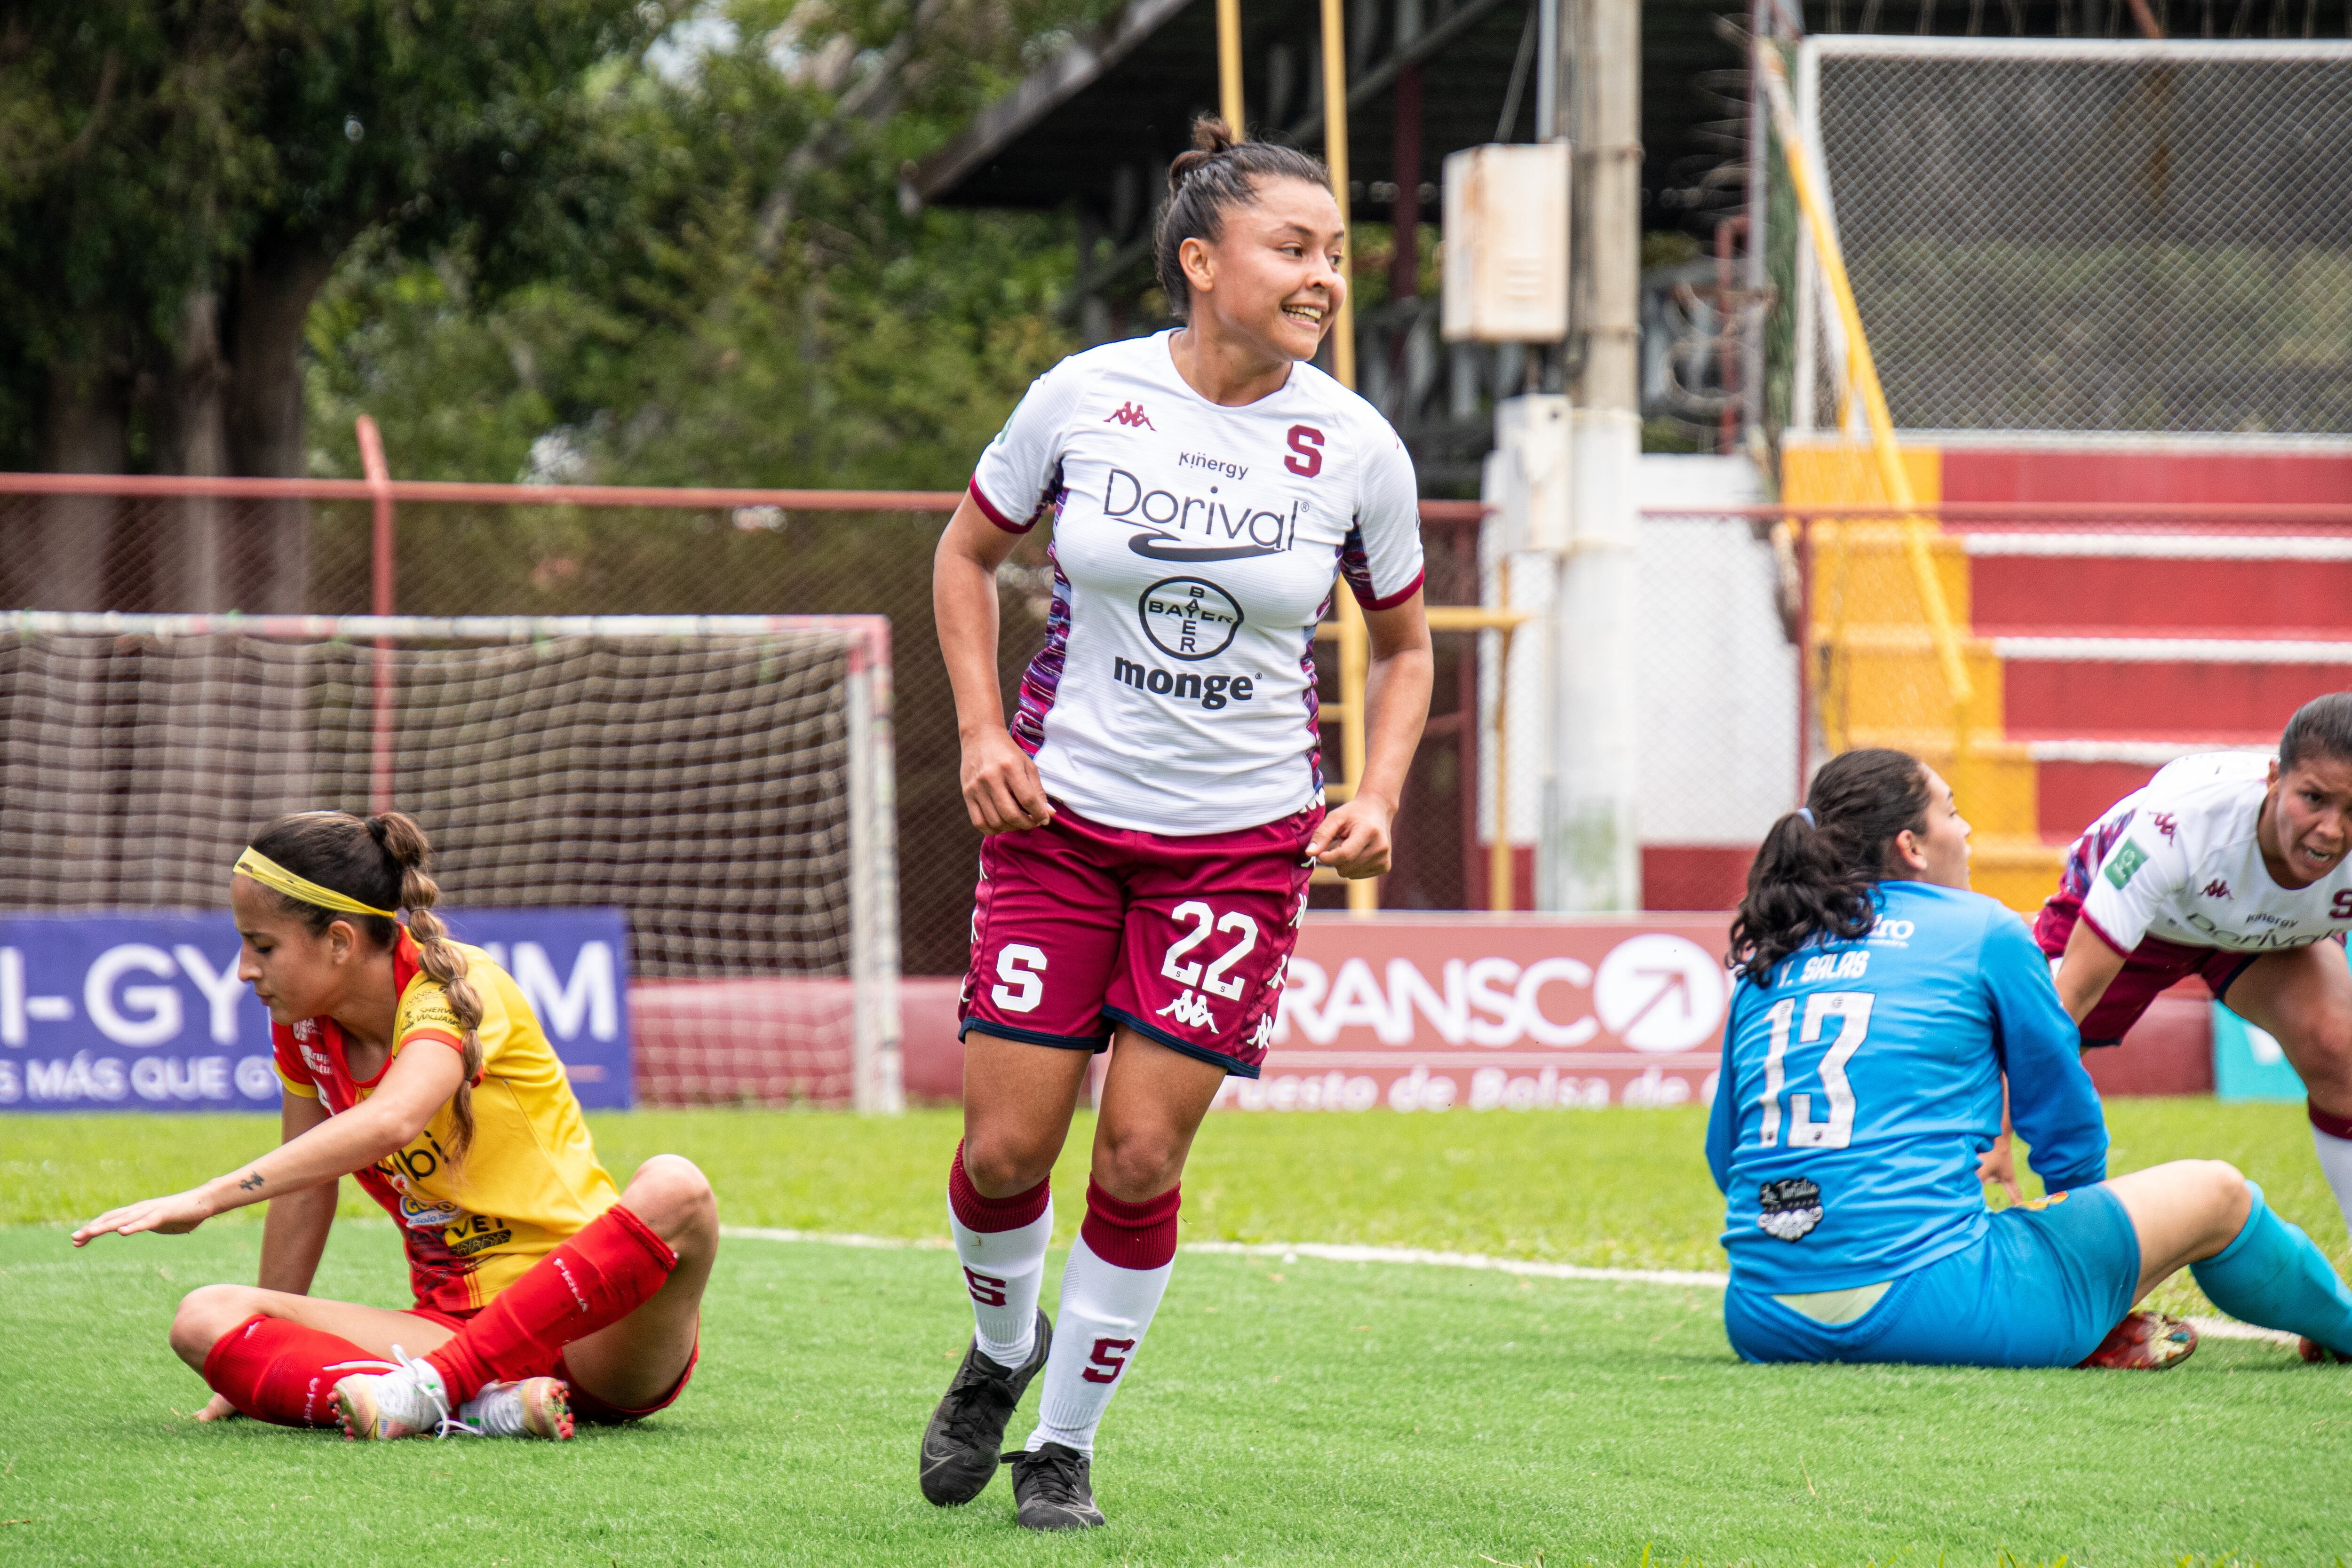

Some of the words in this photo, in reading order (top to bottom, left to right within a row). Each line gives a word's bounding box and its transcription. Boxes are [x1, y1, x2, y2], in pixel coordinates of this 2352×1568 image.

[1284, 425, 1324, 478] S
[1104, 468, 1298, 550] Dorival
[1148, 600, 1233, 623] BAYER
[1179, 586, 1205, 652] BAYER
[1113, 656, 1253, 710] monge
[992, 943, 1047, 1012] S
[1161, 901, 1258, 1001] 22
[1800, 950, 1871, 982] SALAS
[131, 1055, 231, 1101] QUE
[1758, 991, 1876, 1148] 13
[963, 1266, 1007, 1307] S
[1081, 1337, 1136, 1384] S
